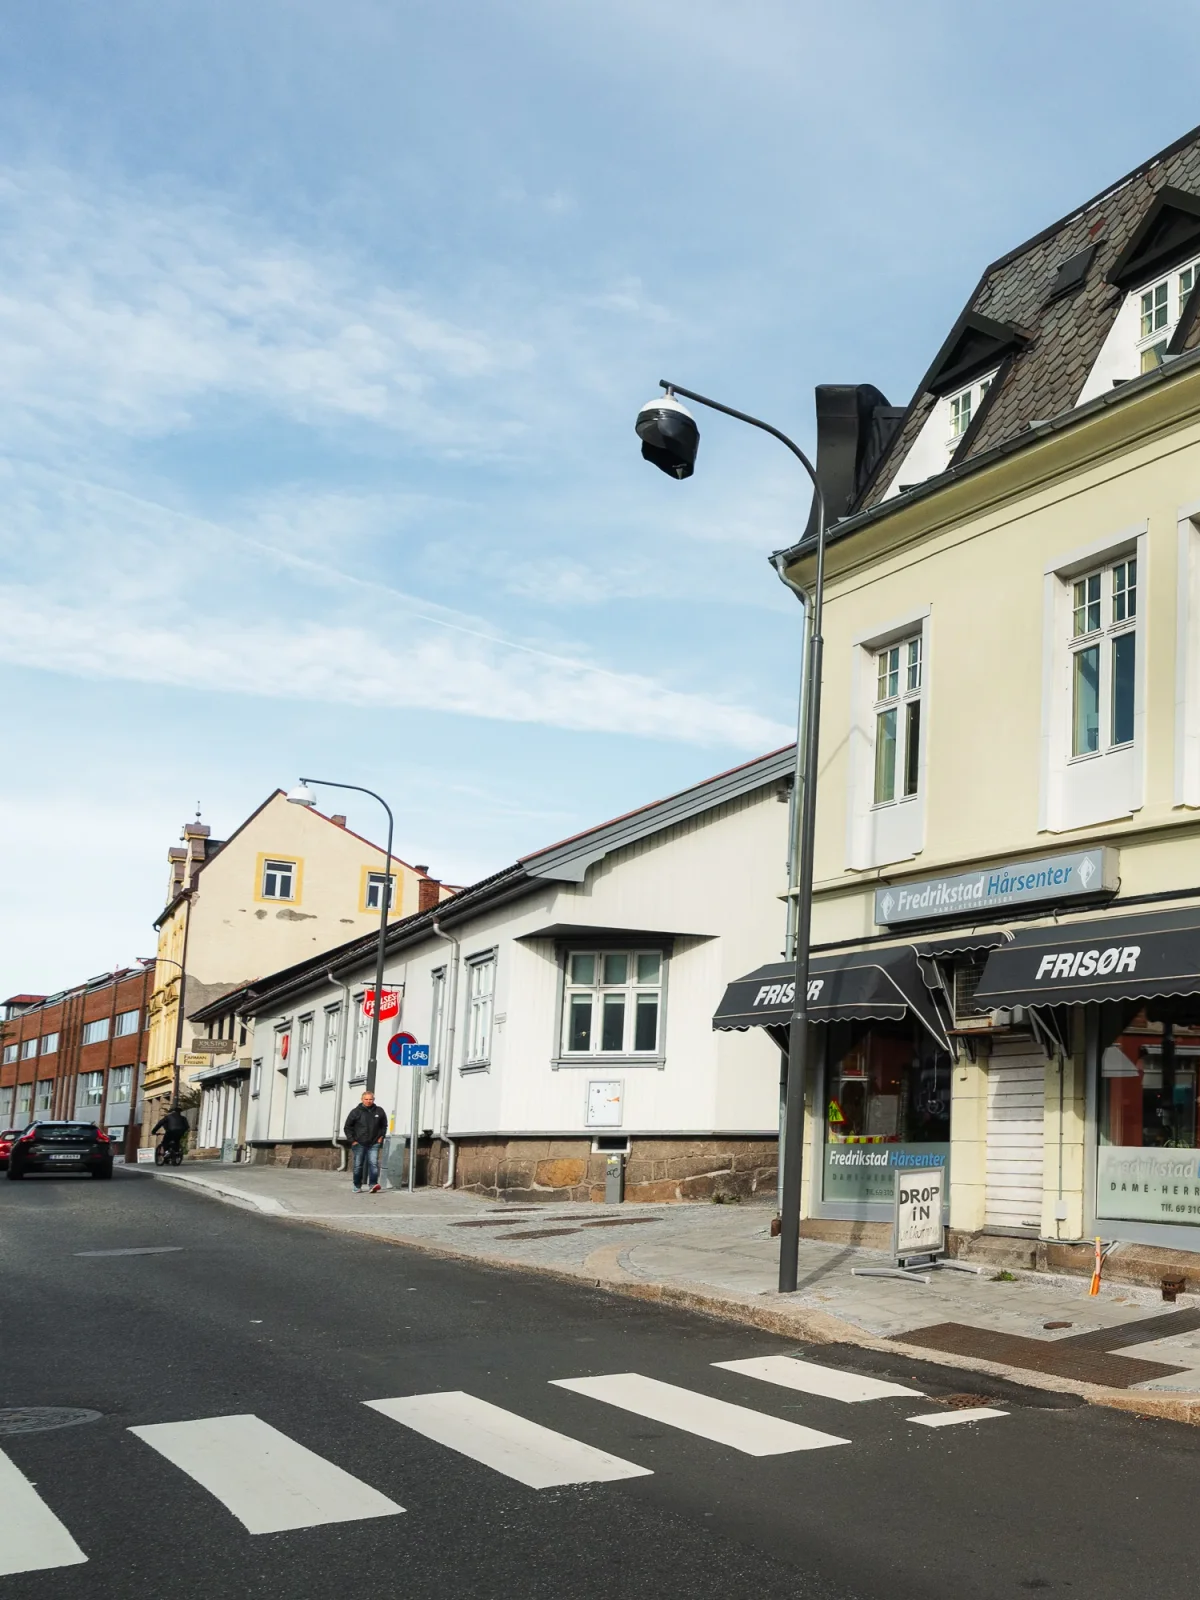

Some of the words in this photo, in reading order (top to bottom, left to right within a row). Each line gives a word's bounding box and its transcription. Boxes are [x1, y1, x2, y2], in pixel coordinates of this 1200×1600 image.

[897, 875, 985, 912] Fredrikstad
[987, 865, 1072, 896] Hårsenter
[1035, 946, 1141, 980] FRISØR
[366, 993, 397, 1010] FRLSES
[752, 979, 824, 1007] FRISR
[369, 1000, 397, 1015] AMEEN
[829, 1150, 889, 1166] Fredrikstad
[889, 1149, 946, 1167] Hårsenter
[899, 1186, 940, 1205] DROP
[1160, 1203, 1173, 1213] Tlf.
[1175, 1204, 1186, 1213] 69
